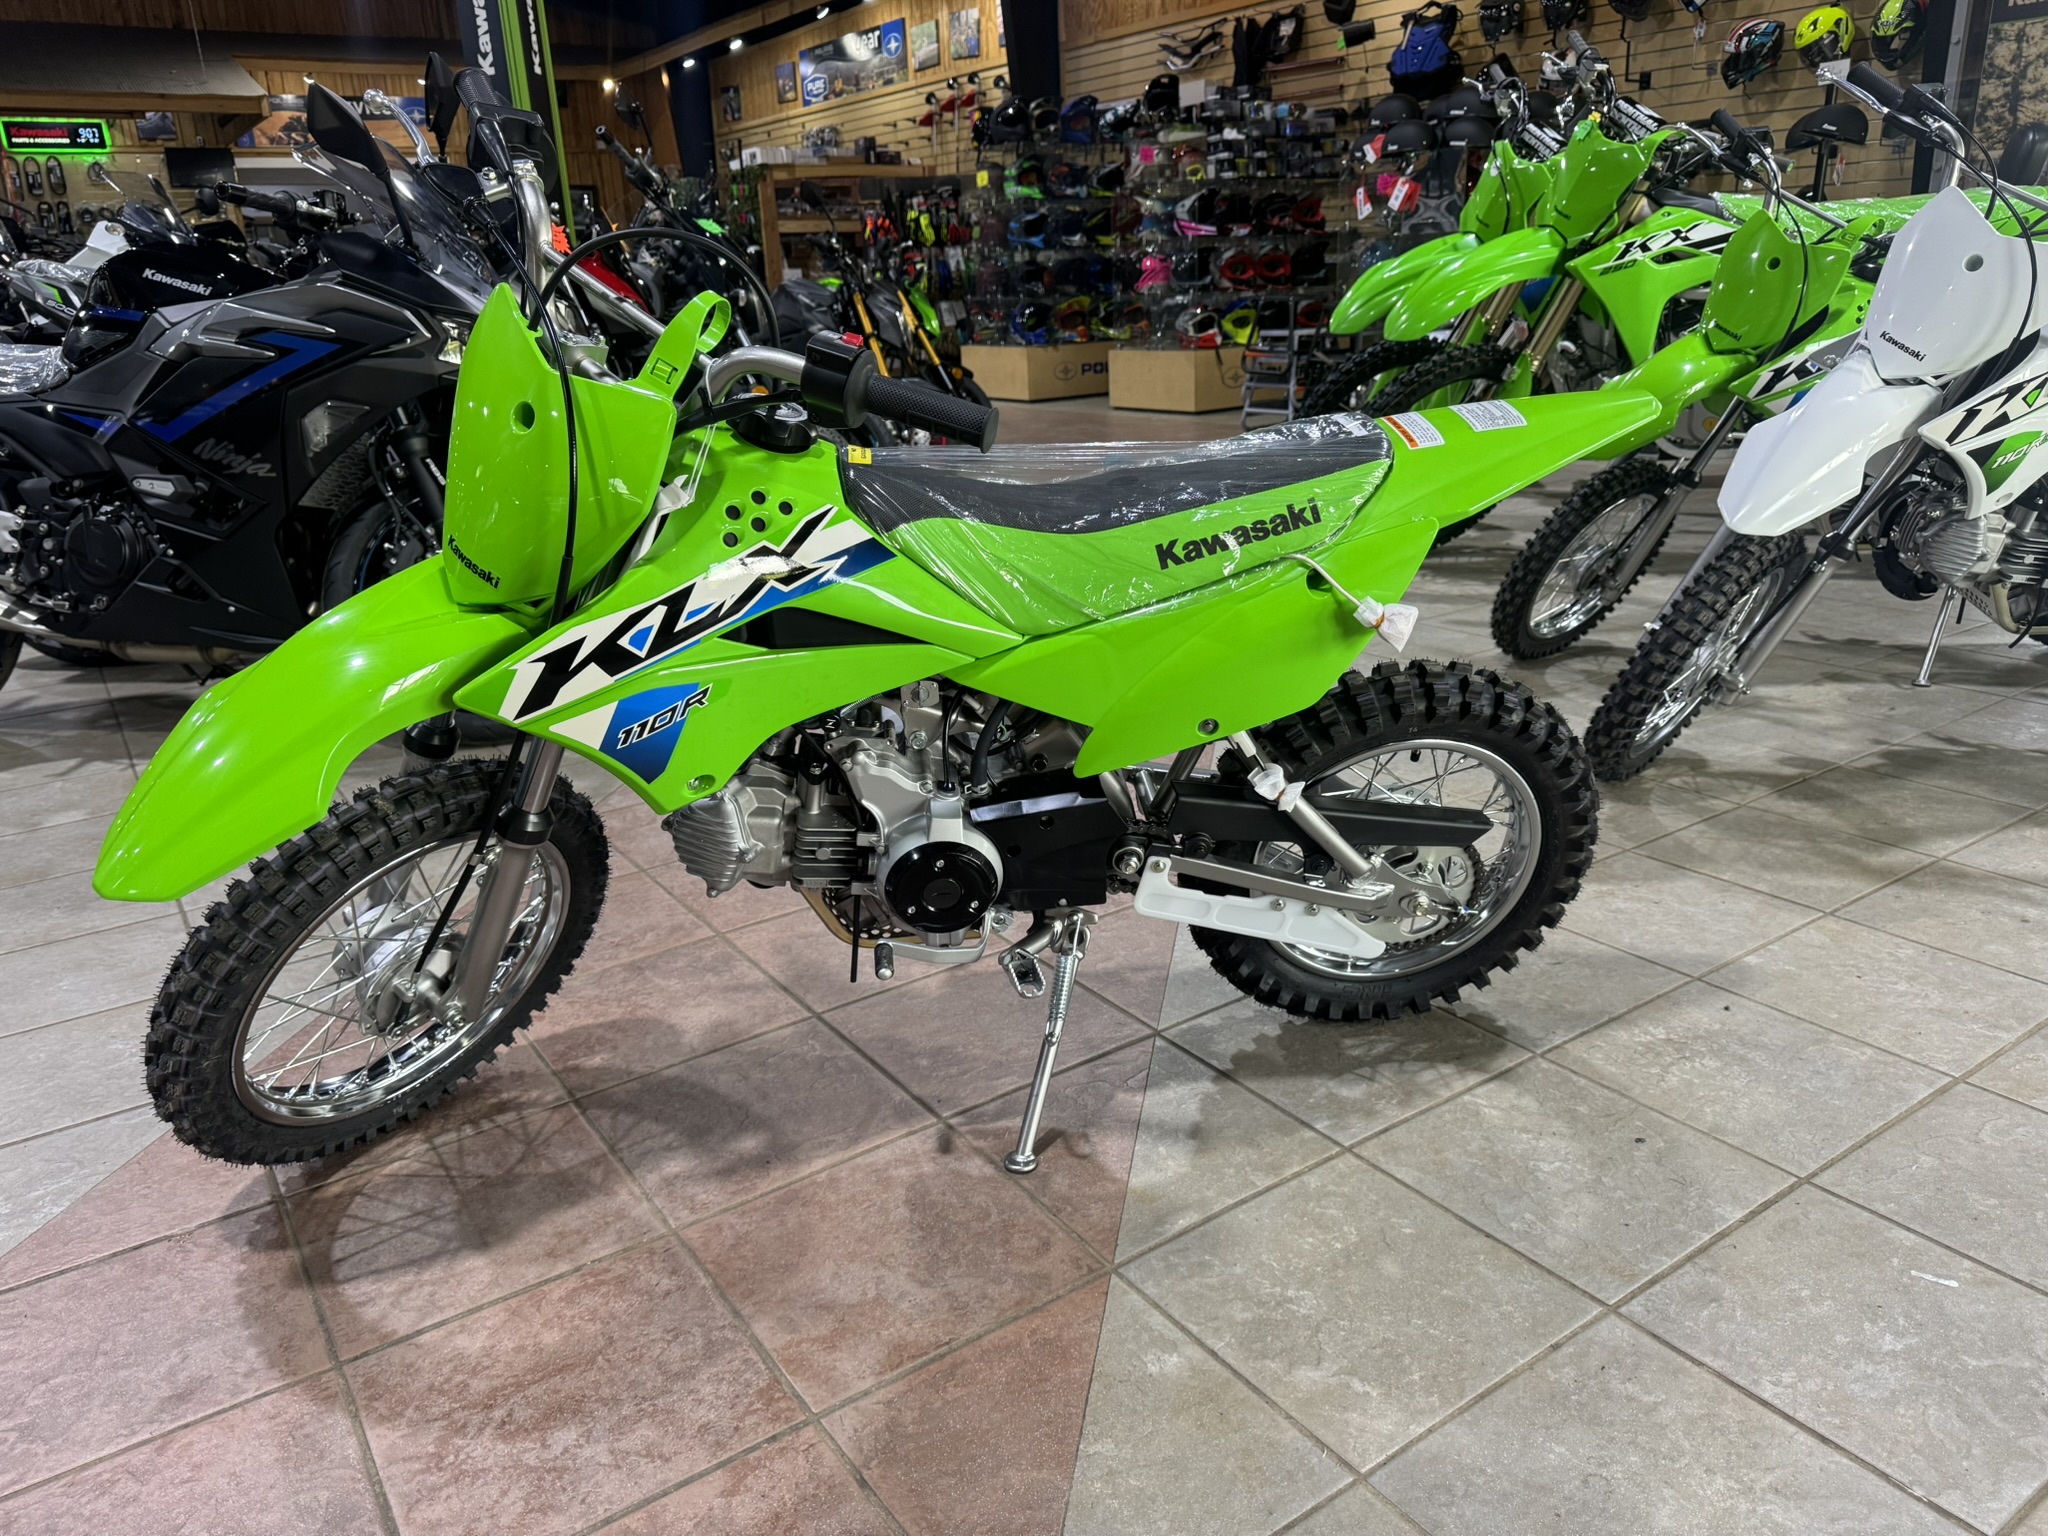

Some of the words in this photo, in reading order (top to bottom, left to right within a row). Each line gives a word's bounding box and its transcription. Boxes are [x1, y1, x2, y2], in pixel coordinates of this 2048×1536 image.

[1612, 219, 1710, 263] KX
[142, 267, 213, 297] Kawasaki
[45, 299, 77, 316] 500
[1879, 330, 1927, 363] Kawasaki
[192, 437, 277, 478] Ninja
[1155, 497, 1322, 571] Kawasaki
[447, 534, 501, 590] Kawasaki
[512, 504, 839, 722] KLX
[616, 682, 714, 750] 110R
